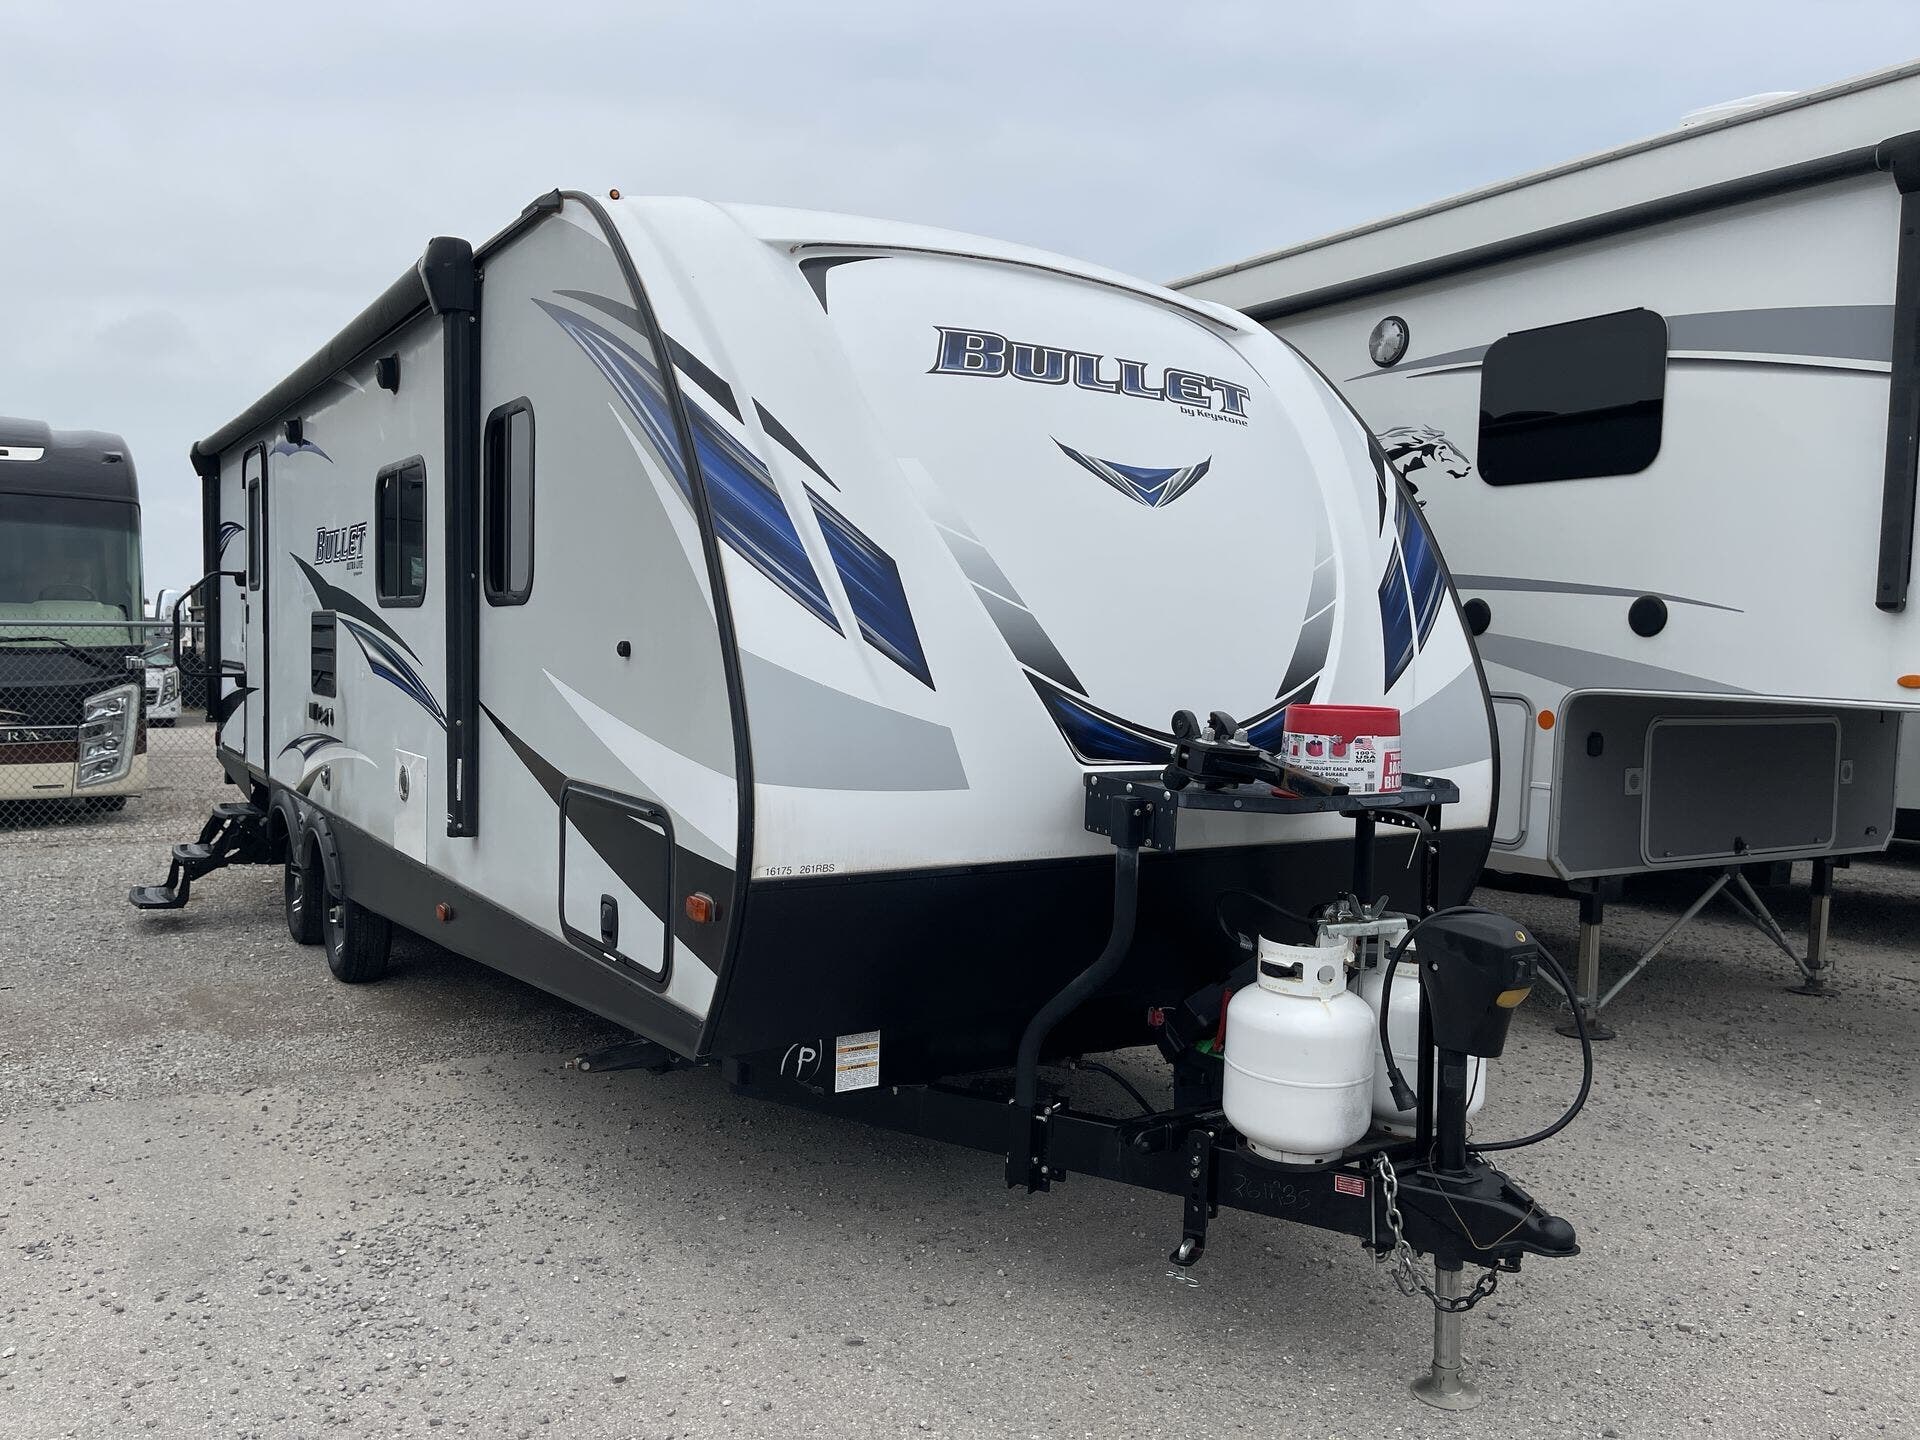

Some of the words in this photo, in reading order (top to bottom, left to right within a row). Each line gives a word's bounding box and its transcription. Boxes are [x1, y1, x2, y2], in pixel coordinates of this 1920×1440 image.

[925, 325, 1251, 418] BULLET
[1179, 405, 1195, 417] by
[1197, 408, 1249, 428] Keystone
[314, 521, 367, 566] BULLET
[766, 866, 792, 876] 16175
[799, 863, 835, 874] 261RBS
